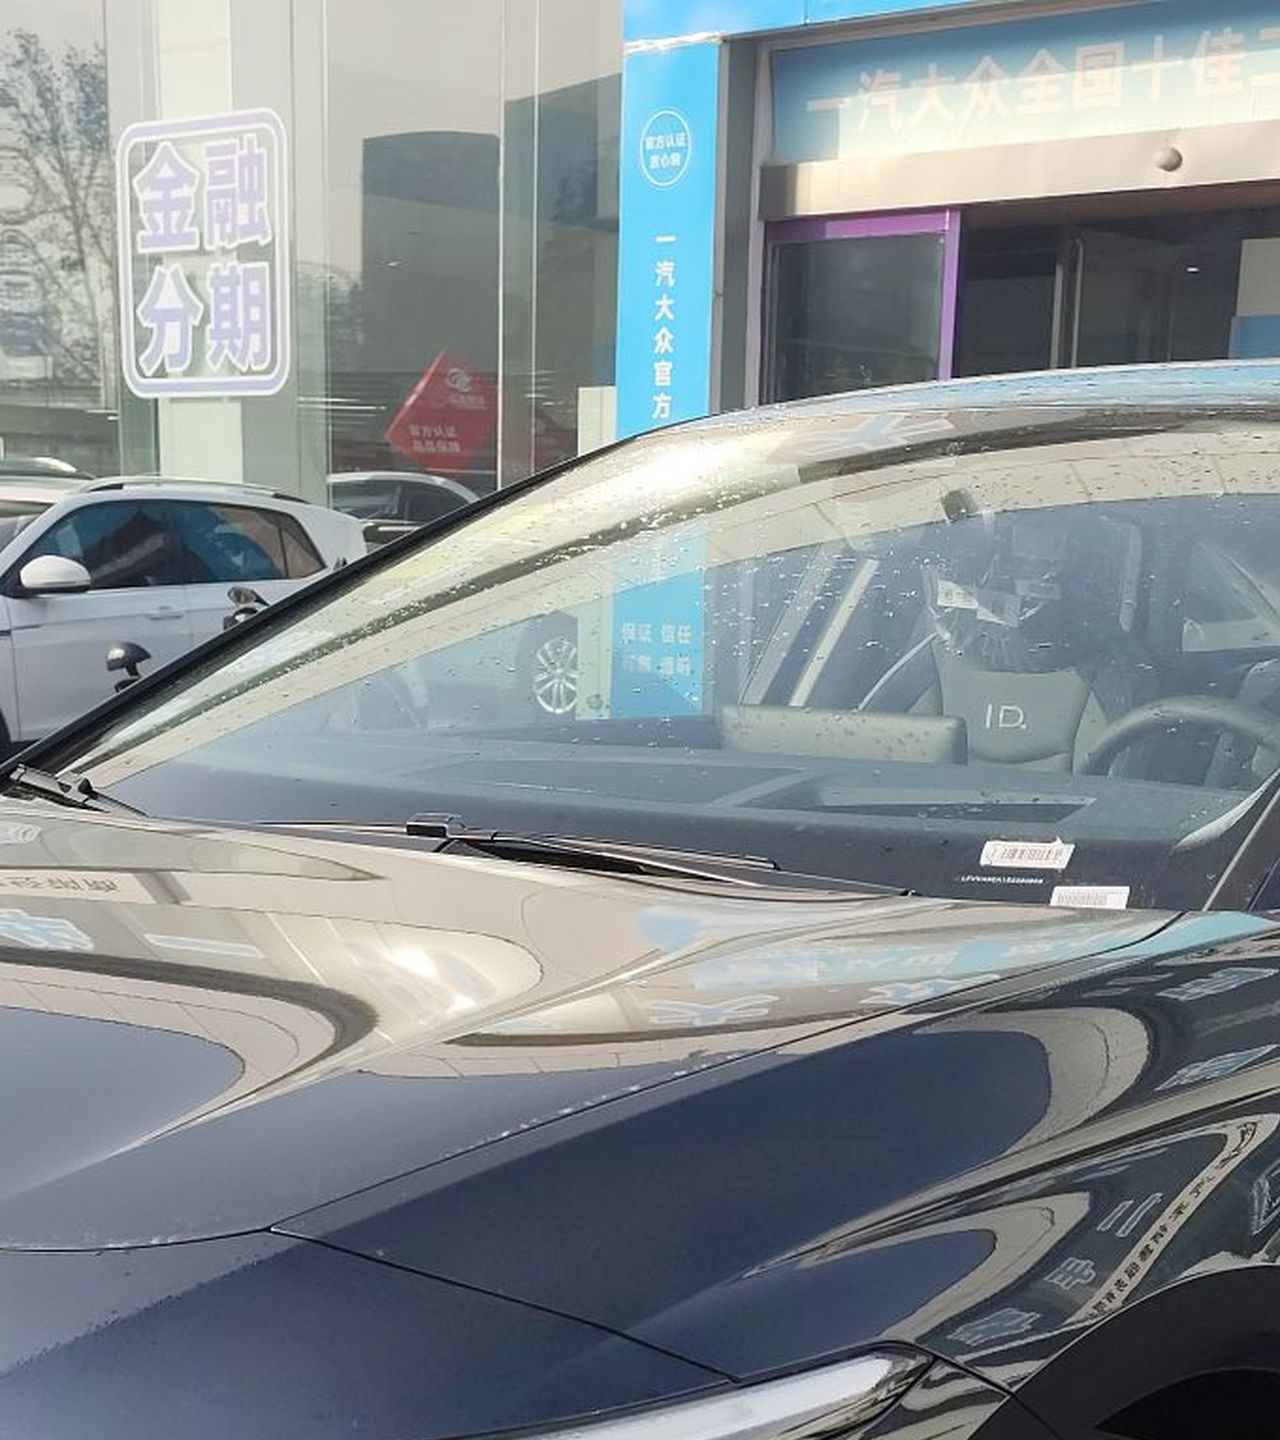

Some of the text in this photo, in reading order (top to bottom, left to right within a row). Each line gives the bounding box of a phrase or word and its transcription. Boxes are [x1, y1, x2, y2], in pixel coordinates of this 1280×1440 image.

[134, 134, 272, 254] 金融
[137, 262, 271, 376] 分期
[652, 235, 677, 419] 一汽大众官方
